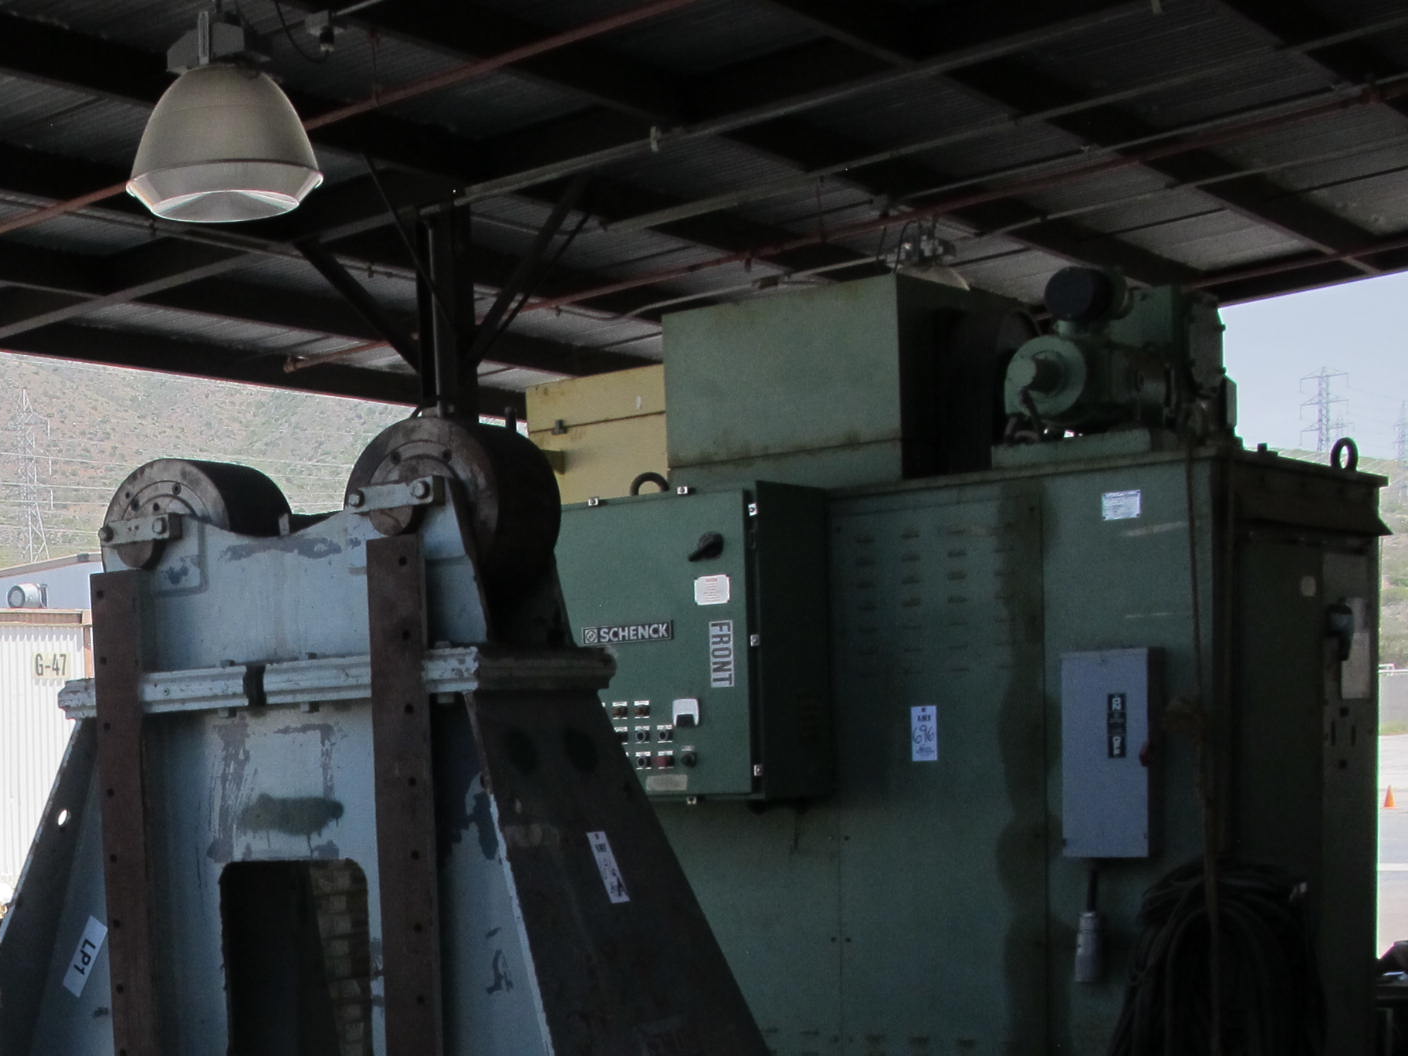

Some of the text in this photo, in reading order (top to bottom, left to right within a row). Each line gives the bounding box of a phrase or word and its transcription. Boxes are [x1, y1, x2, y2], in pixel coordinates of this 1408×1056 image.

[600, 623, 669, 642] SCHENCK
[35, 653, 67, 676] G-47
[710, 621, 733, 686] FRONT
[73, 938, 96, 975] LP1
